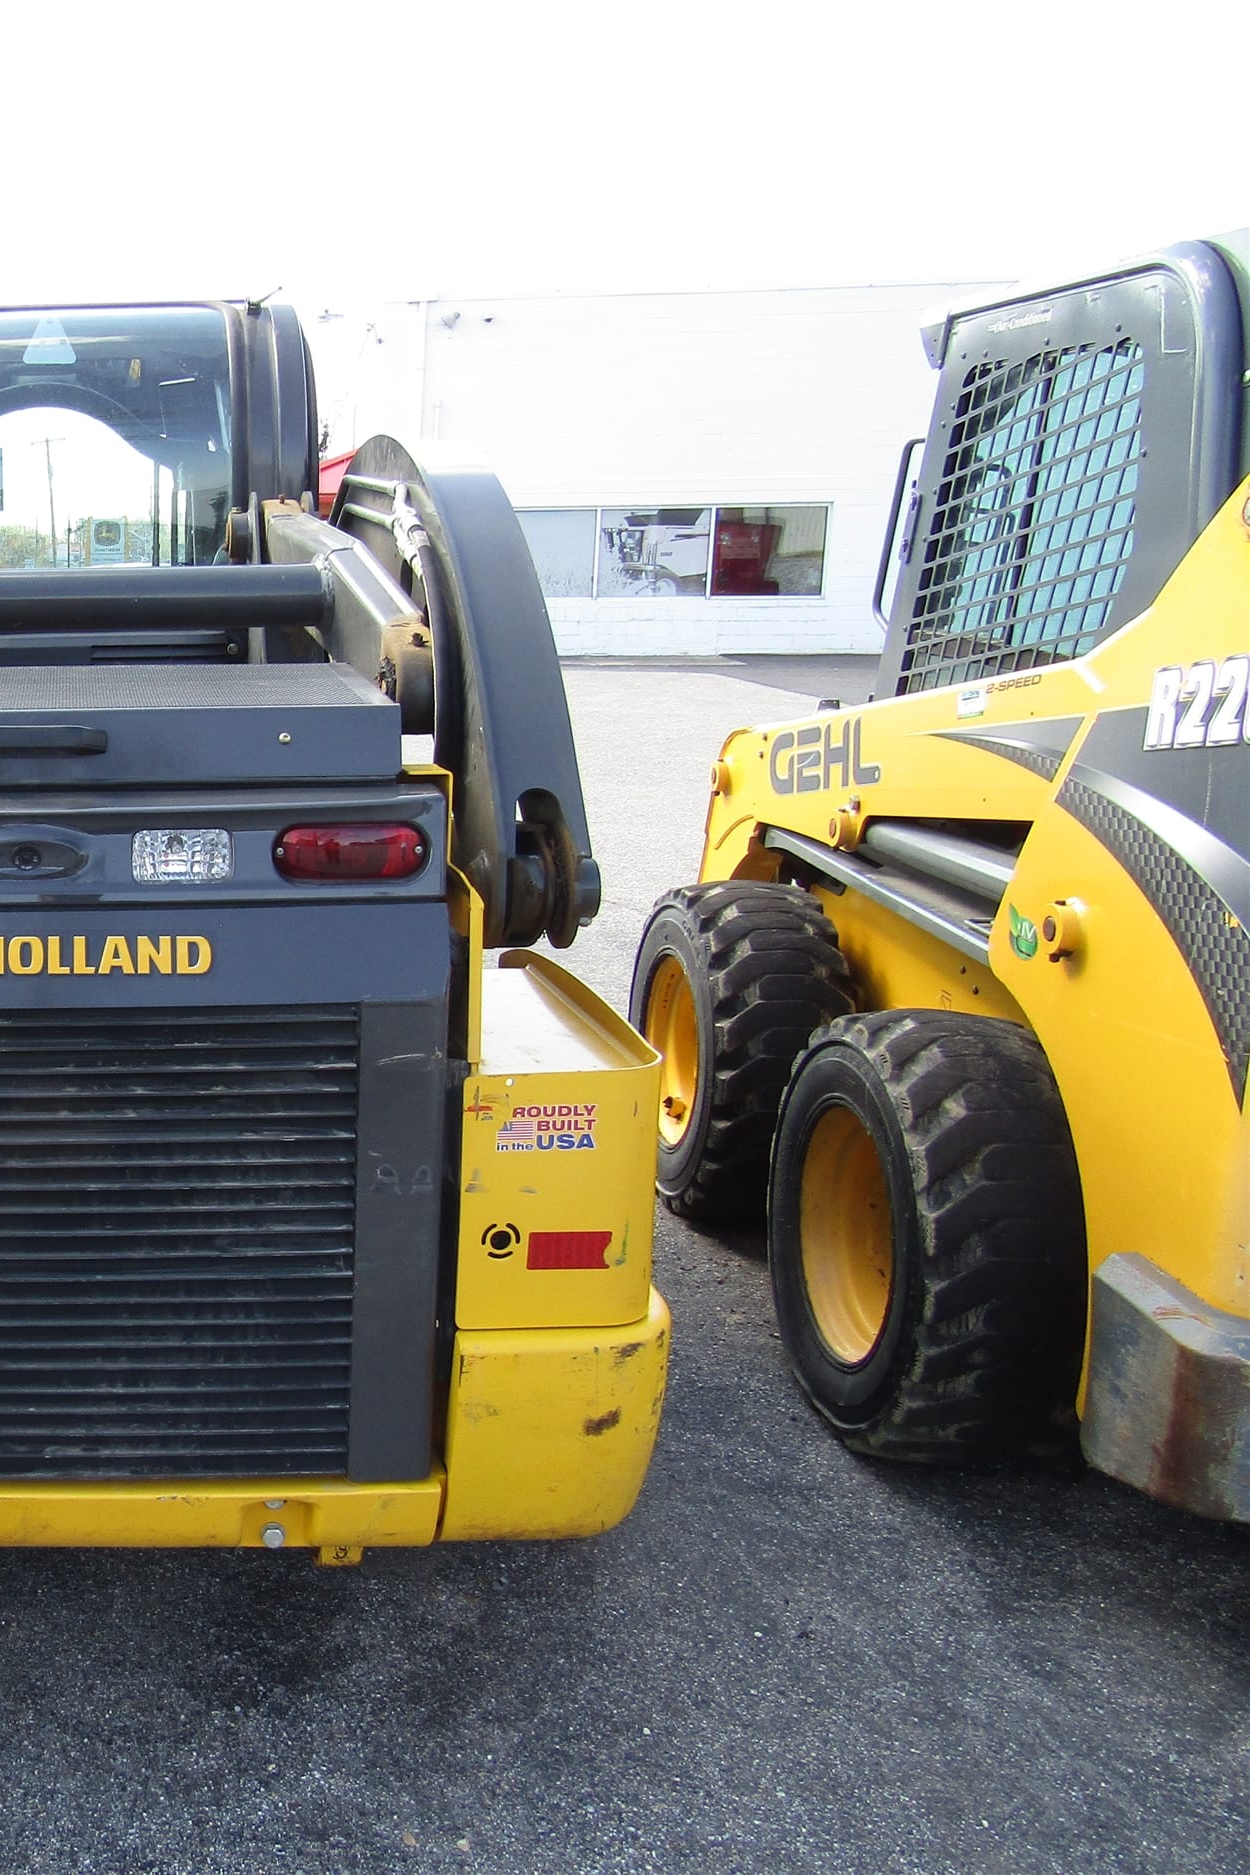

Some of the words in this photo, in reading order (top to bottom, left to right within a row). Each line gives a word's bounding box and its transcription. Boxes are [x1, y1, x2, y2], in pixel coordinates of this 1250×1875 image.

[985, 674, 1042, 694] 2-SPEED
[1142, 653, 1250, 752] R22
[770, 717, 881, 795] GEHL
[536, 1119, 597, 1131] BUILT
[496, 1142, 509, 1151] in
[512, 1142, 534, 1151] the
[536, 1133, 595, 1150] USA
